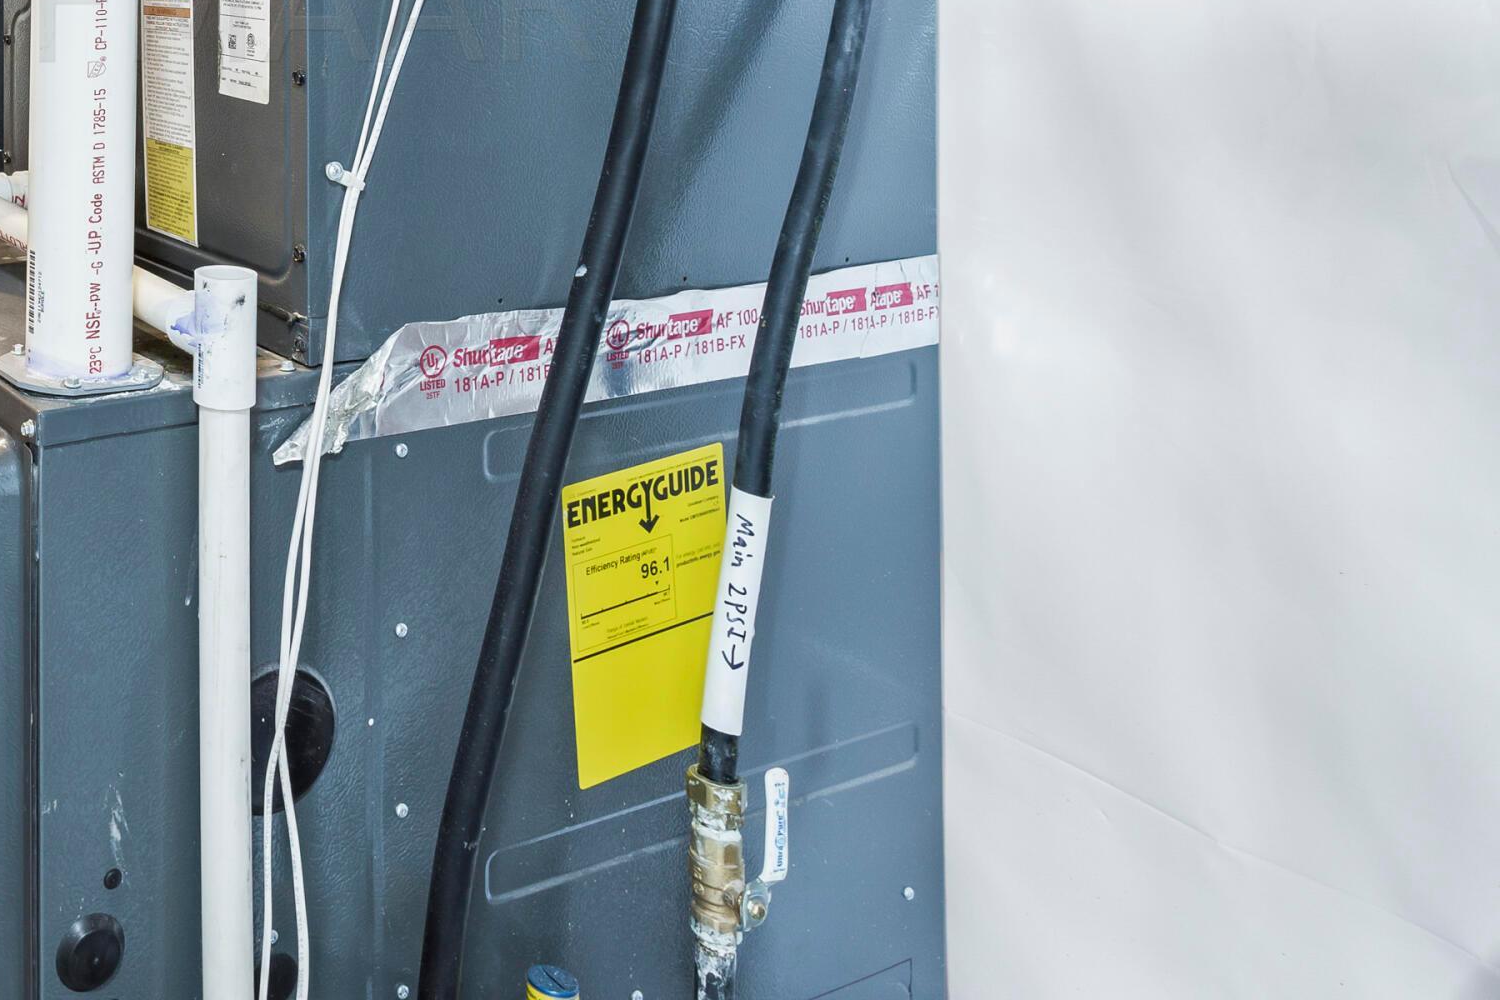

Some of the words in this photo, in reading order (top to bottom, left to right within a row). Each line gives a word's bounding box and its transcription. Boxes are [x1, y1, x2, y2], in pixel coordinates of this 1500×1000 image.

[93, 88, 106, 136] 1785-15
[93, 142, 105, 150] D
[92, 155, 105, 185] ASTM
[89, 193, 103, 224] Code
[916, 284, 931, 301] AF
[636, 315, 700, 342] Shurtape
[716, 312, 733, 330] AF
[736, 308, 758, 326] 100
[799, 319, 841, 340] 181A-P
[452, 341, 528, 368] Shurtape
[637, 345, 683, 365] 181A-P
[695, 333, 747, 355] 181B-FX
[419, 378, 446, 392] LISTED
[454, 372, 505, 394] 181A-P
[566, 459, 719, 530] ENERGYGUIDE
[731, 513, 755, 568] Main
[585, 558, 619, 576] Efficiency
[619, 551, 642, 566] Rating
[640, 555, 671, 579] 96.1
